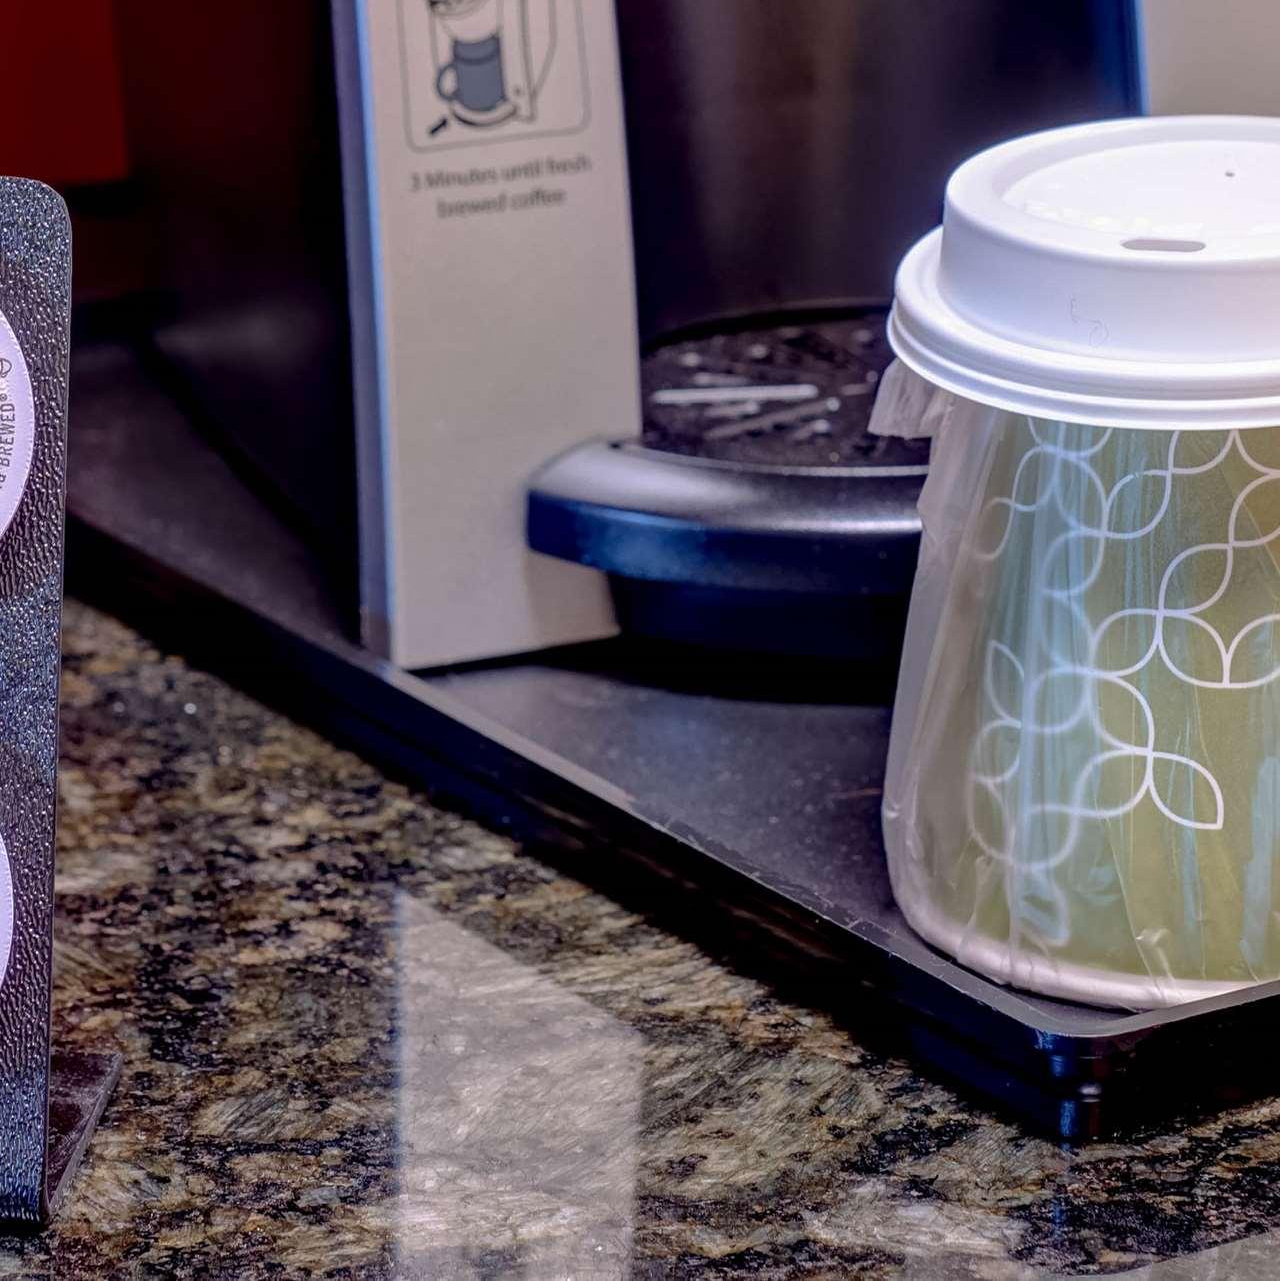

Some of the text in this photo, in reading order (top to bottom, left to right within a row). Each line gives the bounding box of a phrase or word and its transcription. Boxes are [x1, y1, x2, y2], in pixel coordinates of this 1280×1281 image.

[425, 168, 497, 189] Minutes
[502, 159, 542, 181] until
[545, 155, 592, 176] fresh
[436, 189, 566, 218] brewed coffee
